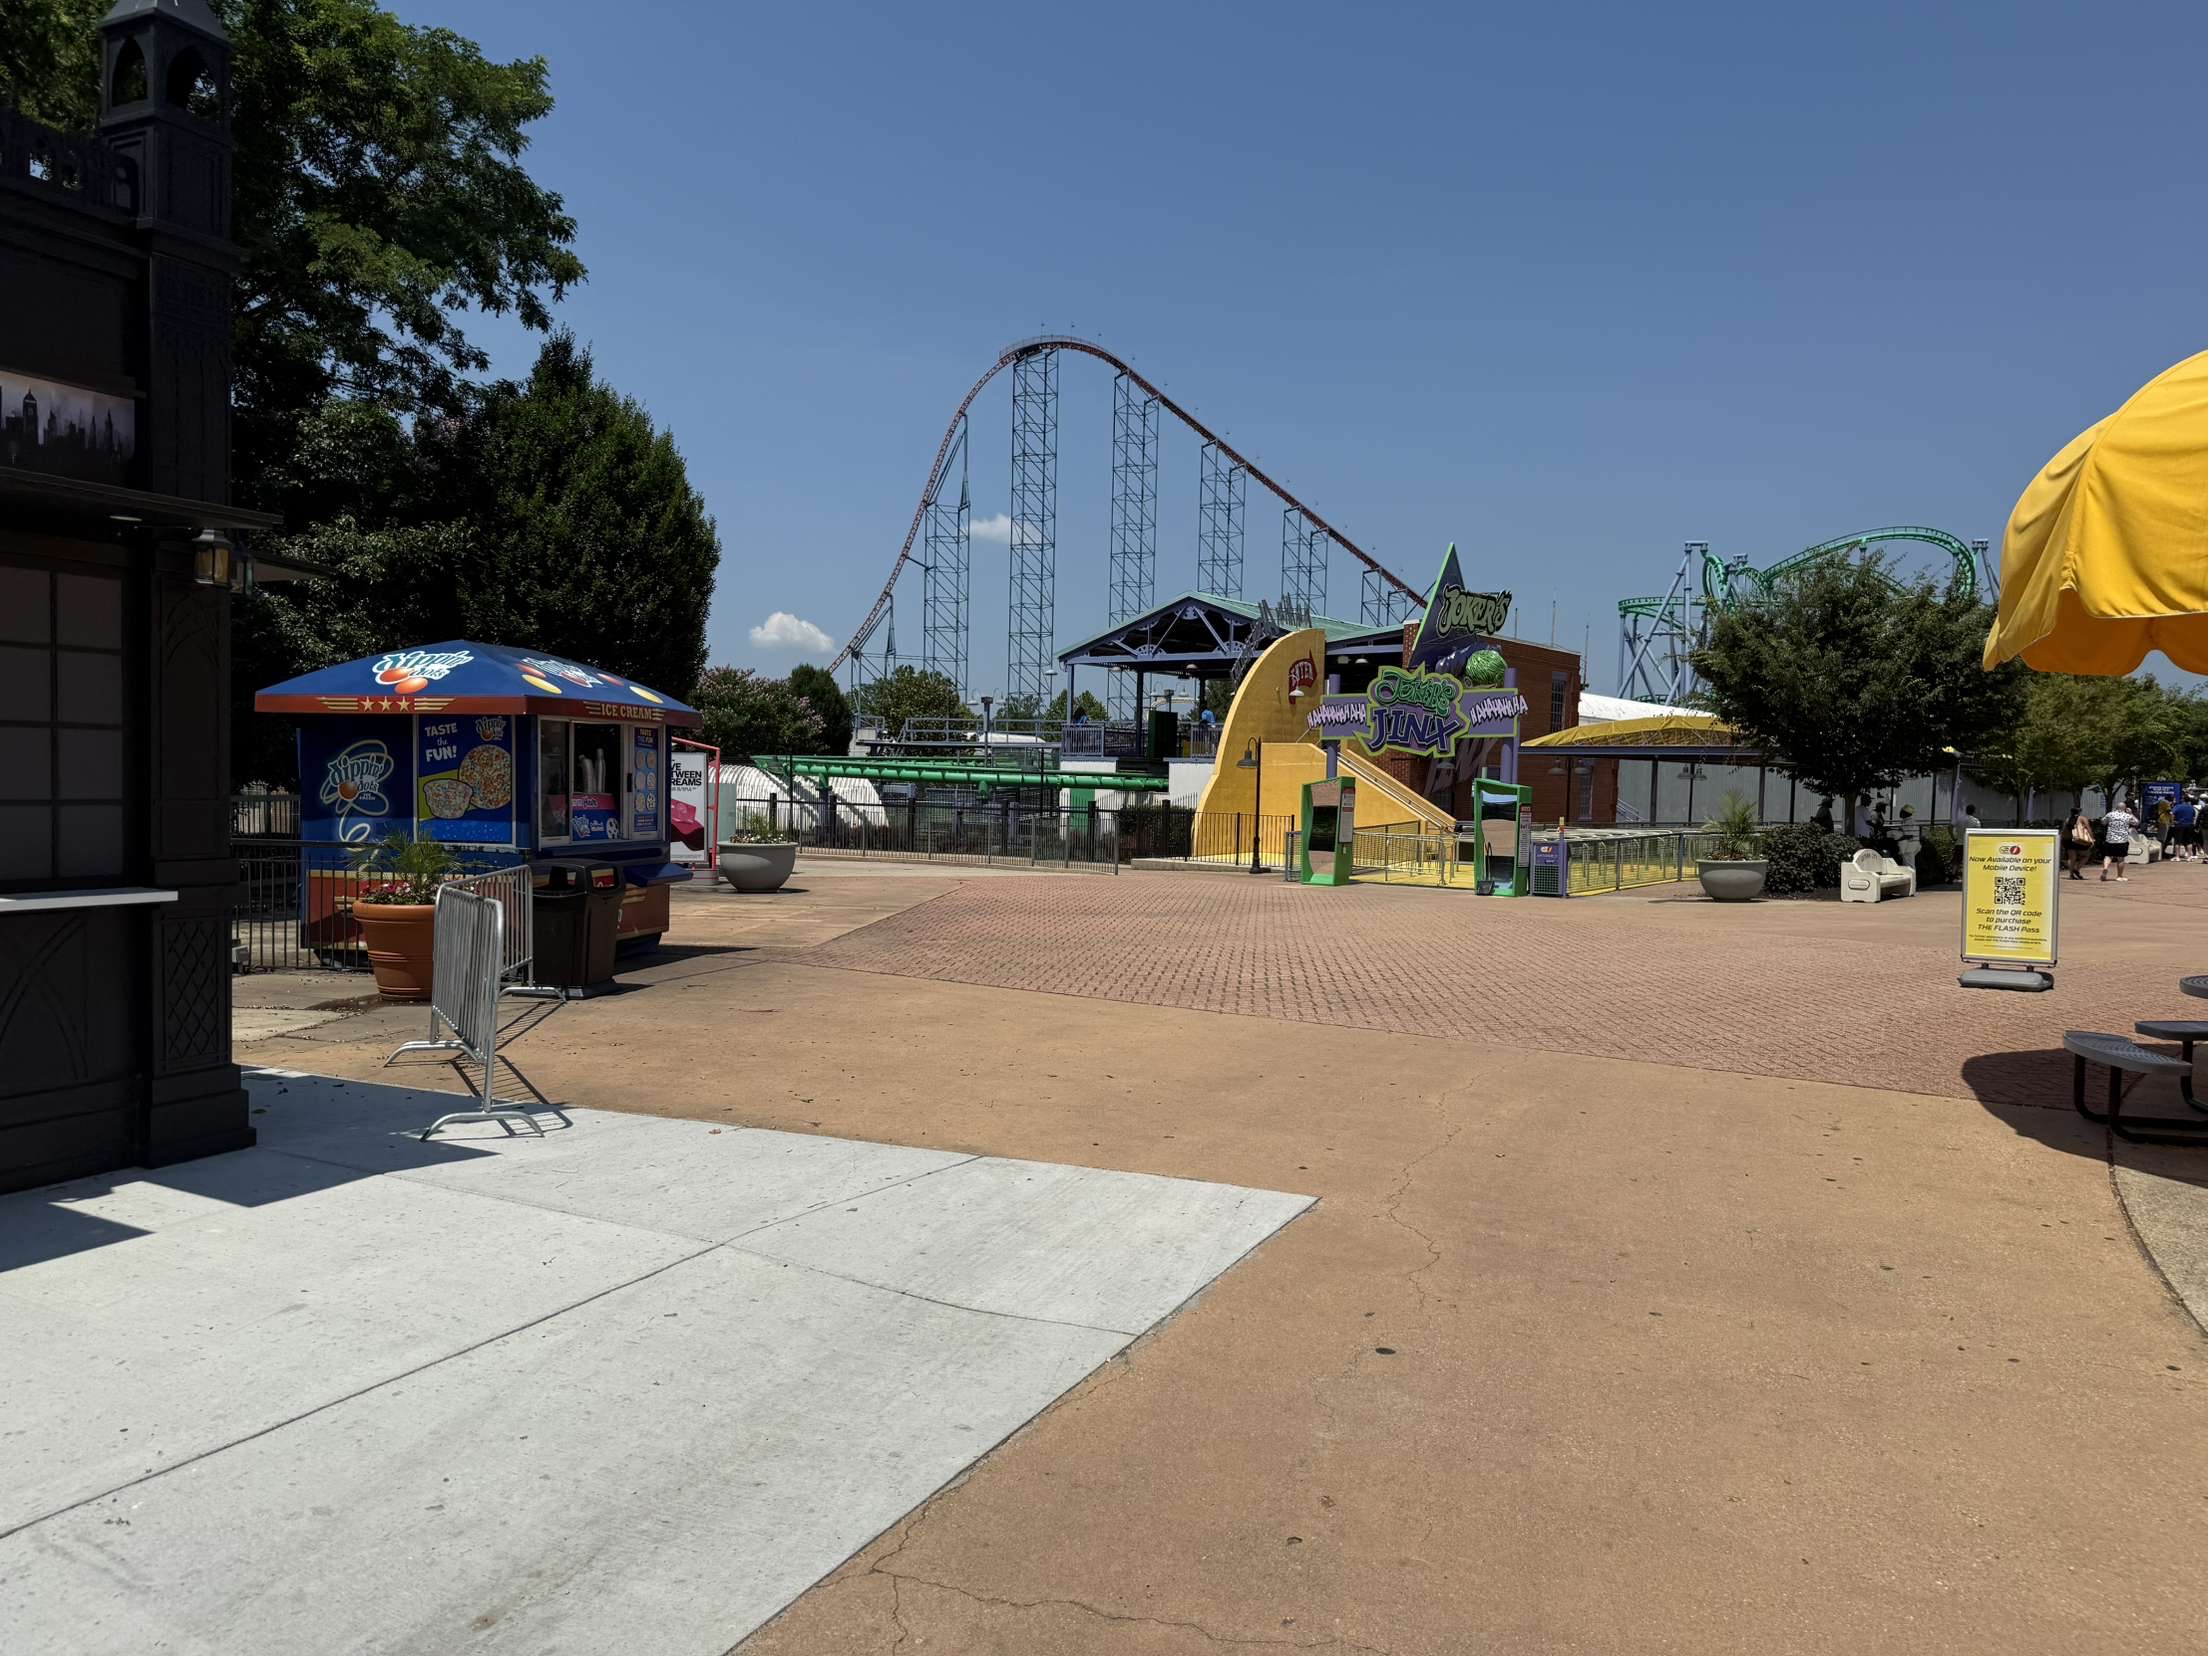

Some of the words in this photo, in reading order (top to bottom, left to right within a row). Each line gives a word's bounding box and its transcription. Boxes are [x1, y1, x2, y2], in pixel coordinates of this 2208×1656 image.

[601, 703, 618, 717] ICE
[621, 704, 652, 720] CREAM
[424, 722, 458, 737] TASTE
[1369, 707, 1461, 751] JINX
[425, 745, 457, 762] FUN!
[671, 770, 702, 779] TWEEN
[671, 778, 702, 786] REAMS
